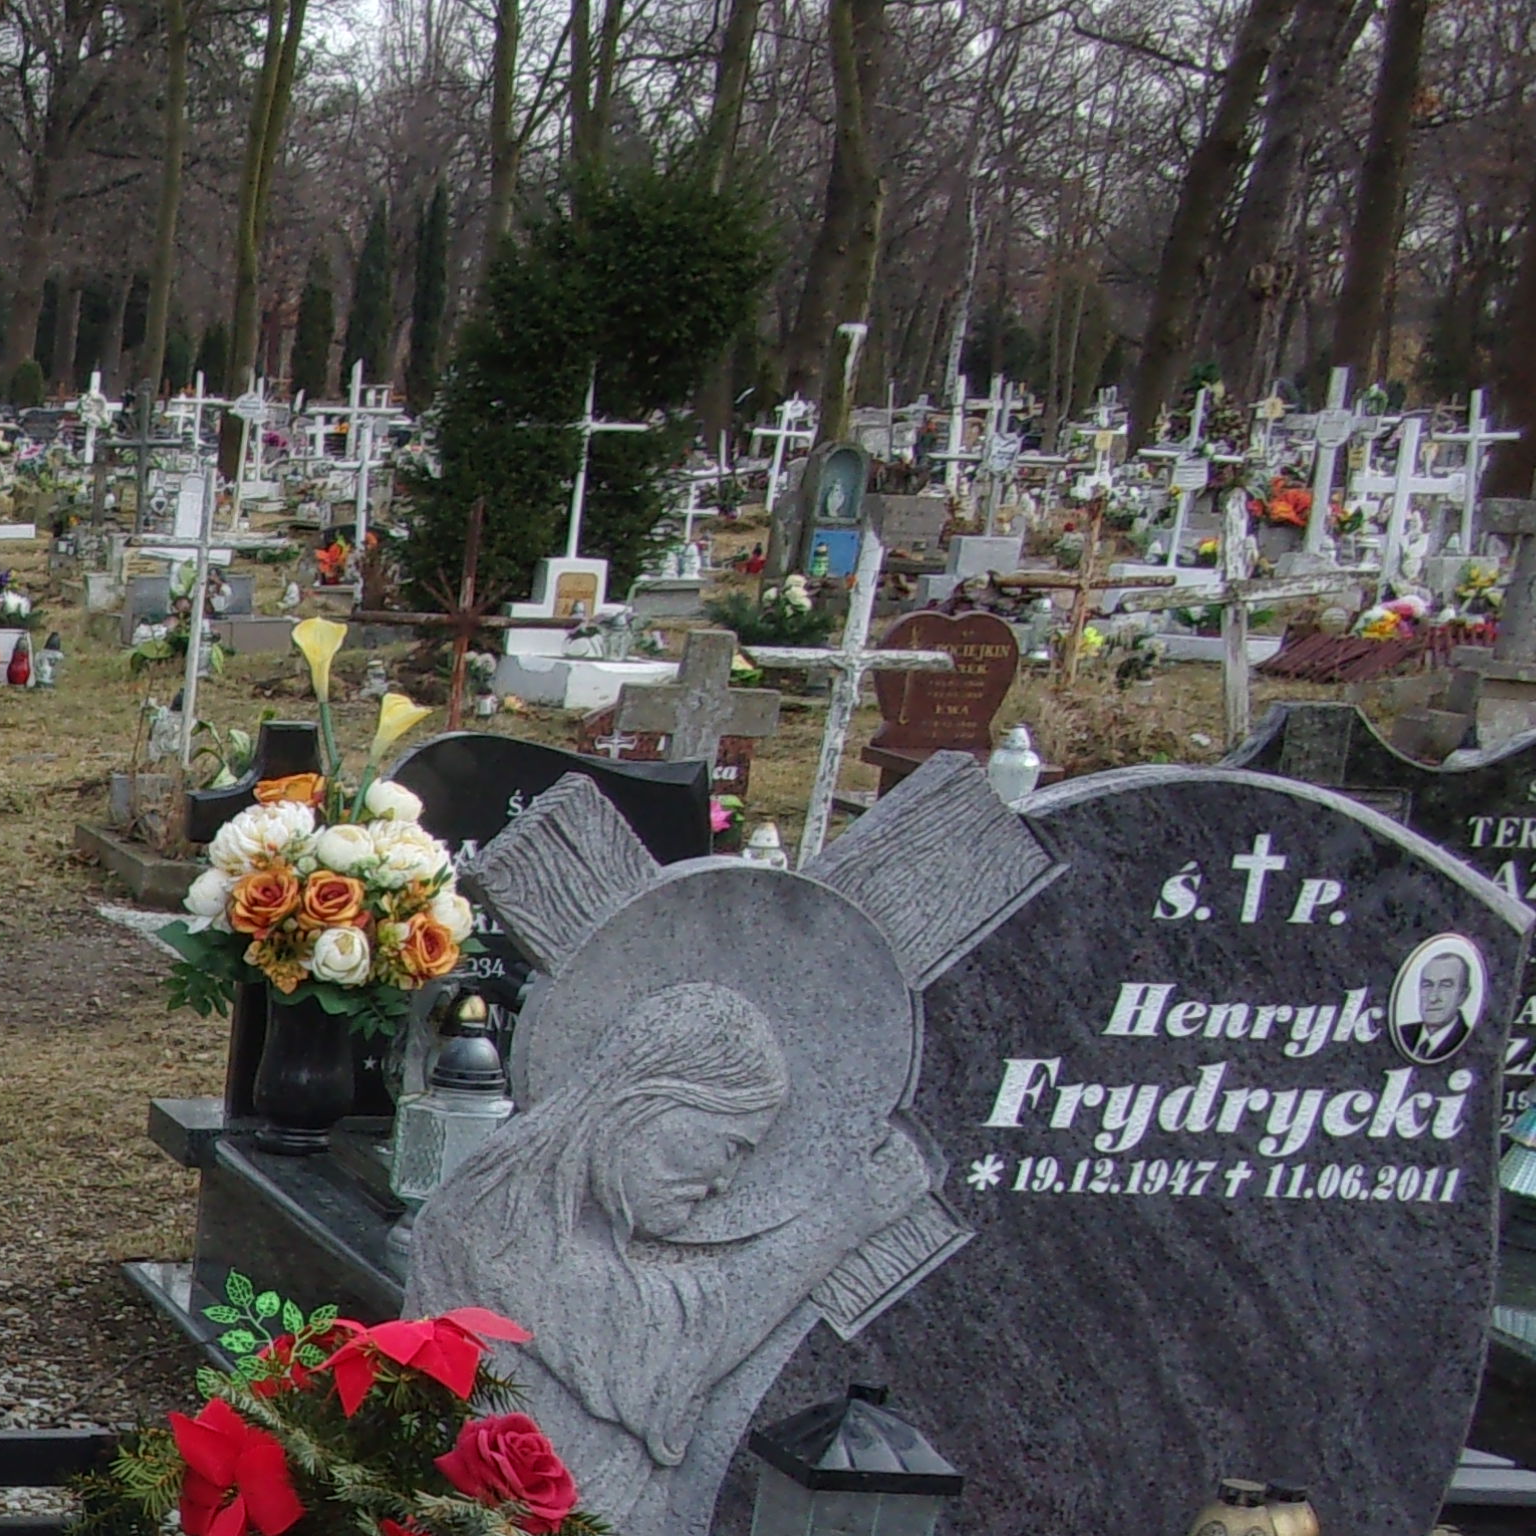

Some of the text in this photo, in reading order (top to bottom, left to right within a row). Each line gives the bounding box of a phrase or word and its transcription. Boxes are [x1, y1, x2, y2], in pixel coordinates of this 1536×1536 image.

[1102, 981, 1383, 1059] Henryk
[982, 1056, 1475, 1158] Frydrycki
[1011, 1157, 1461, 1203] 19.12.1947 11.06.2011
